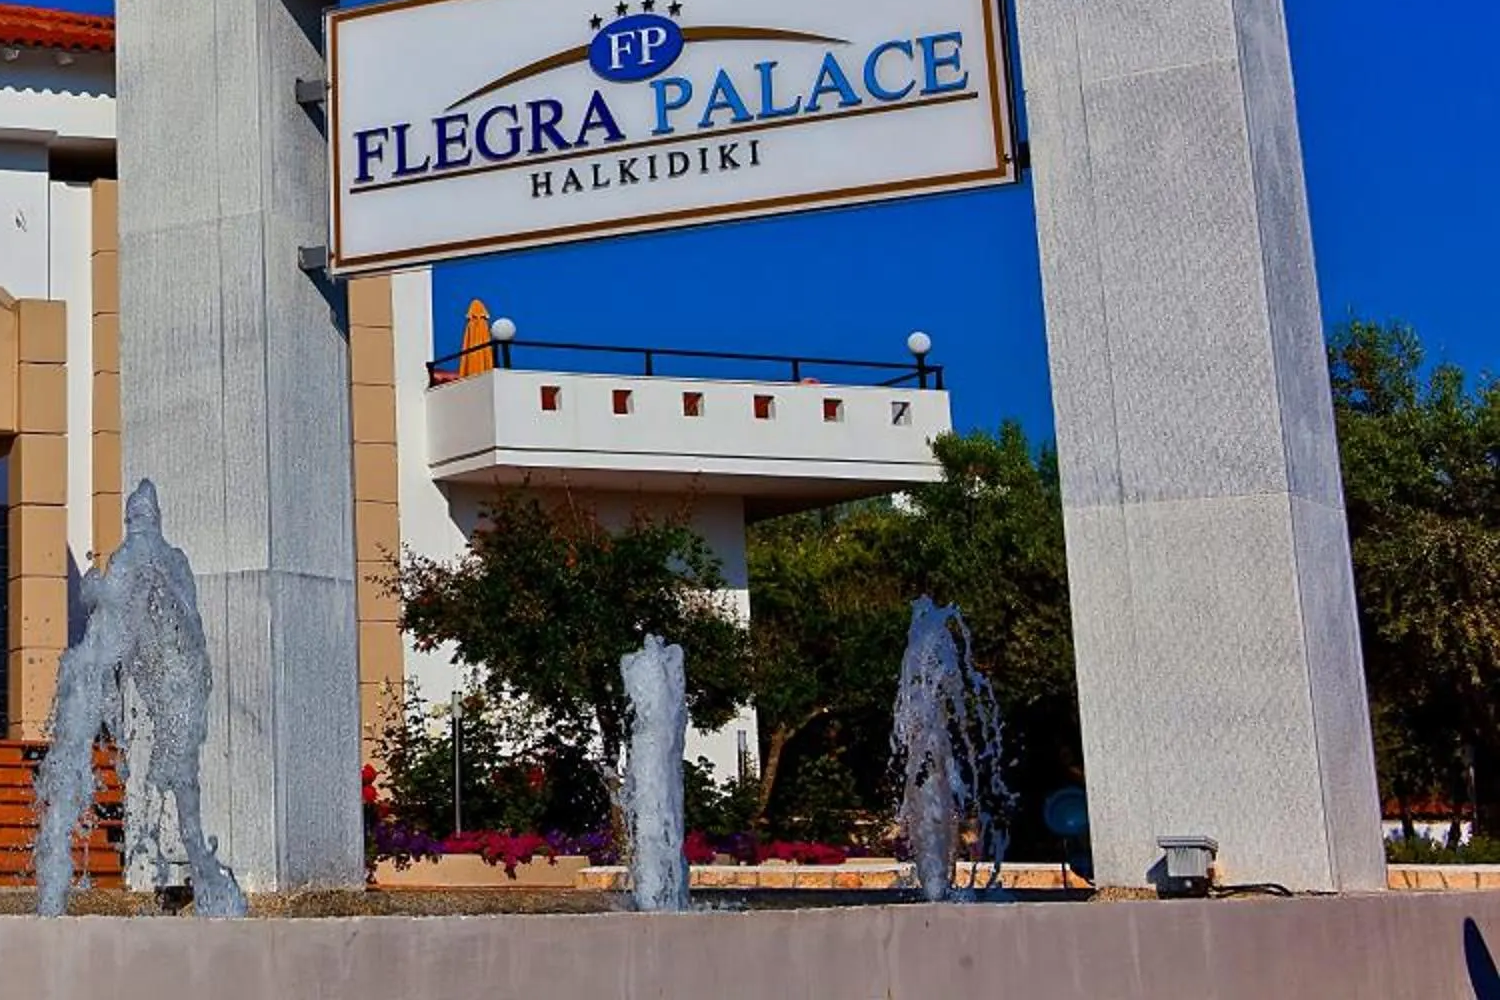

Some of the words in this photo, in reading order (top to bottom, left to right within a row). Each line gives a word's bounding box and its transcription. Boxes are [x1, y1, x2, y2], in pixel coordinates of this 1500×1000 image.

[608, 24, 668, 70] FP
[353, 90, 626, 185] FLEGRA
[650, 31, 970, 136] PALACE
[531, 139, 762, 198] HALKIDIKI
